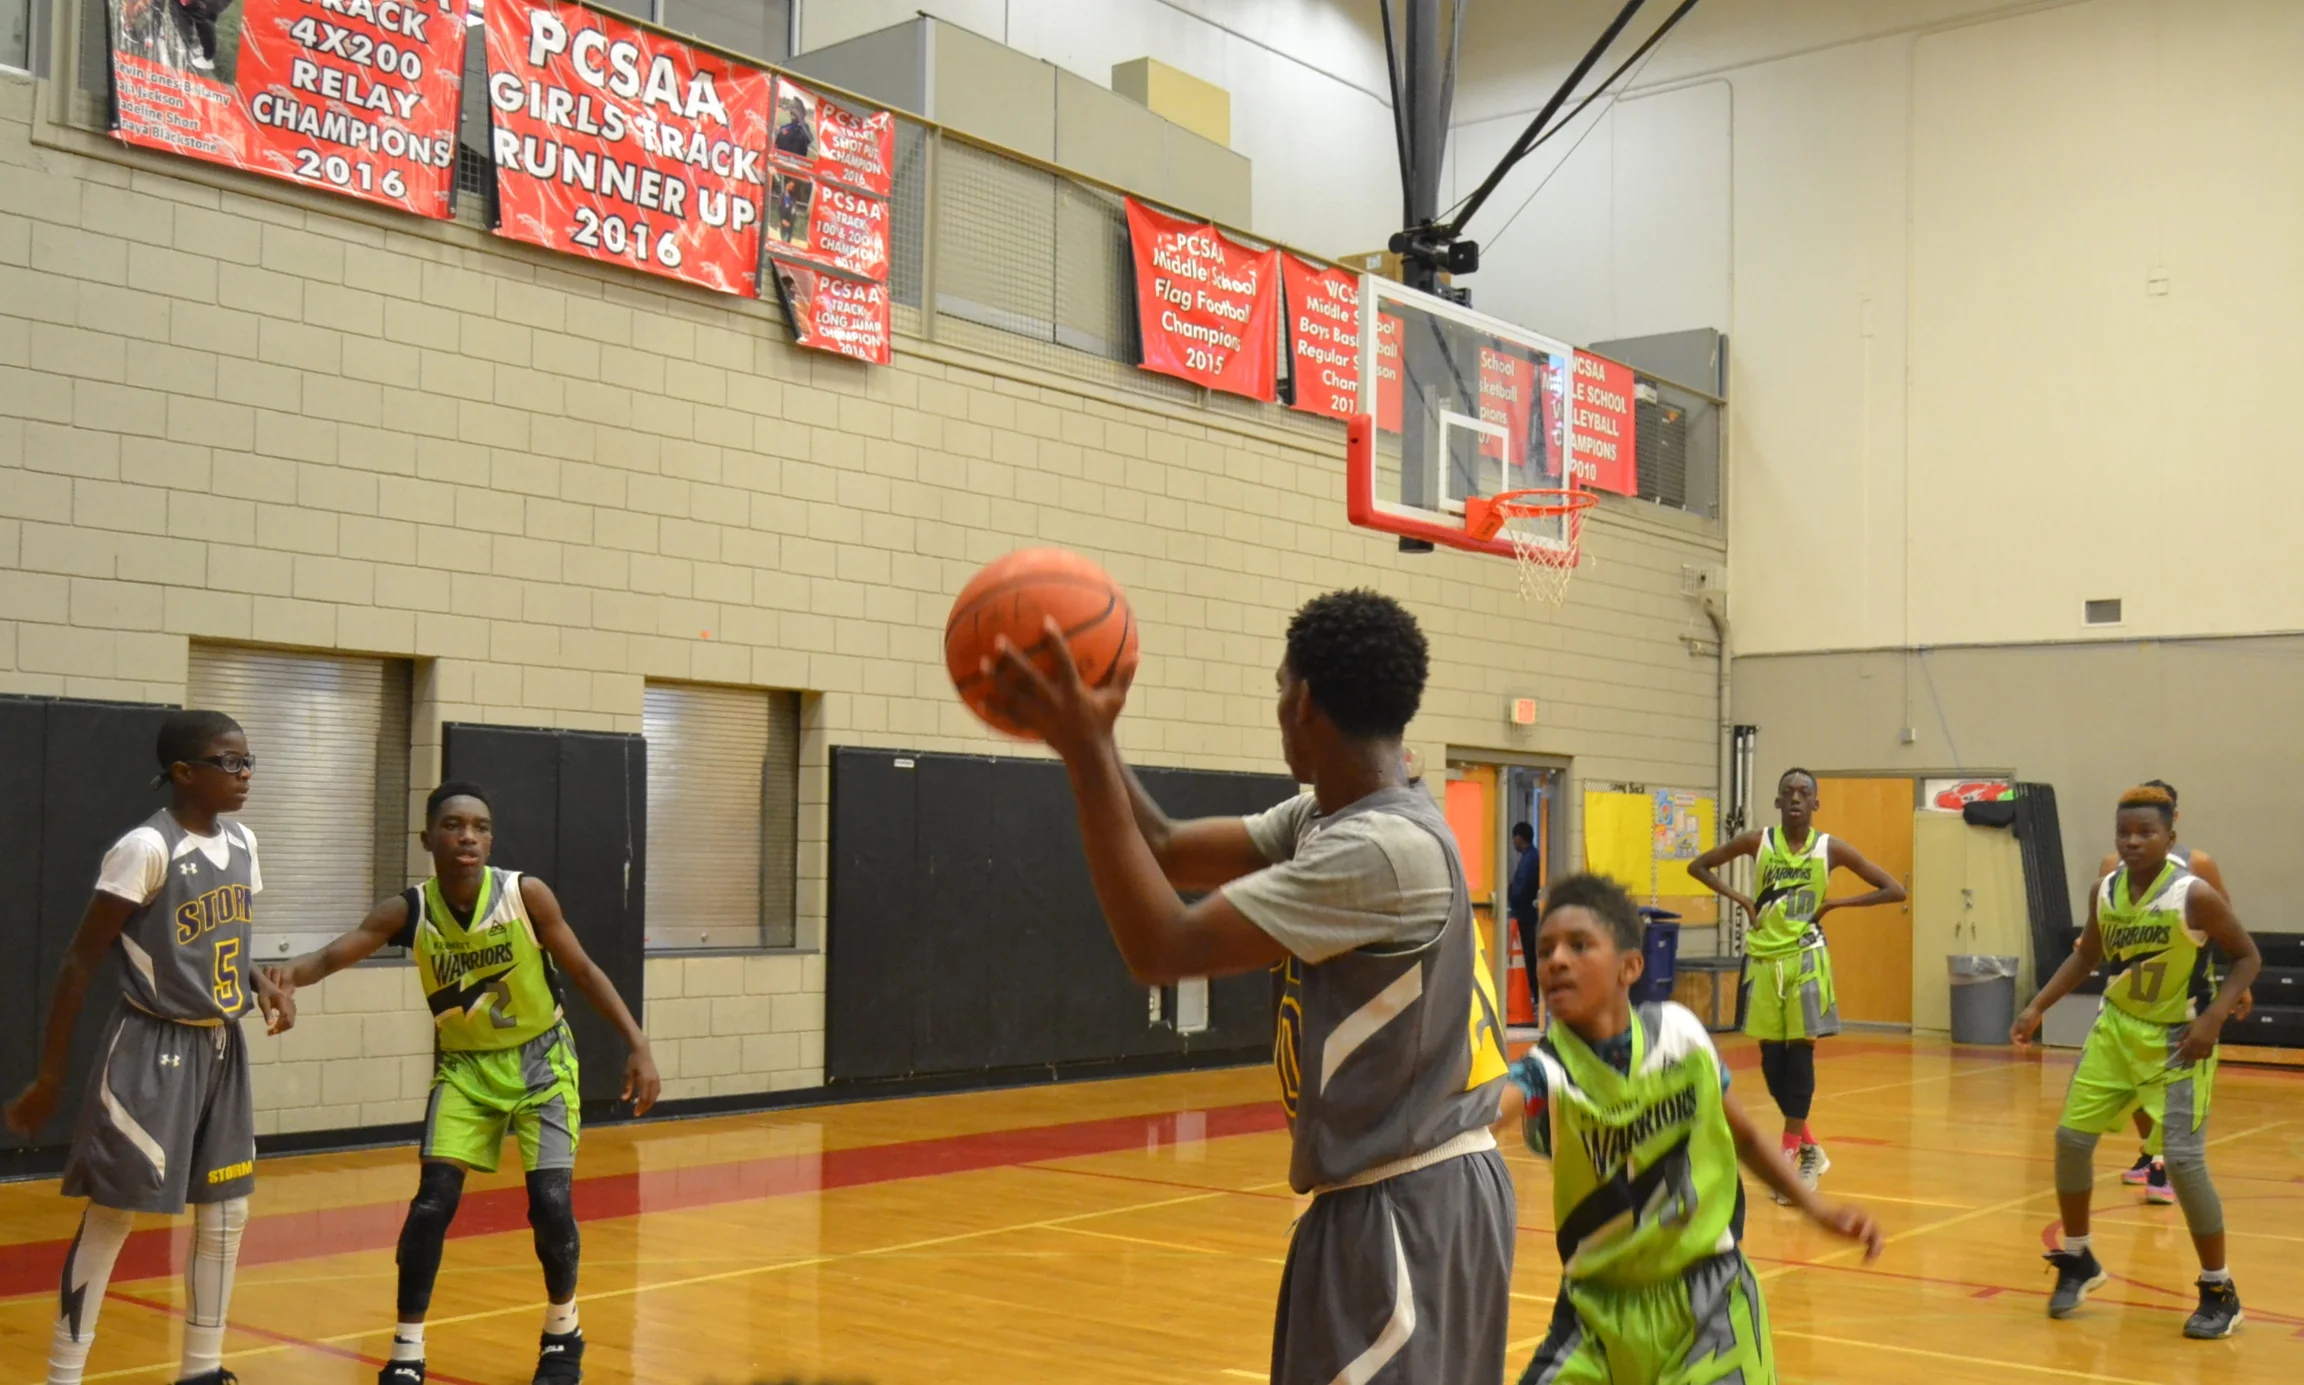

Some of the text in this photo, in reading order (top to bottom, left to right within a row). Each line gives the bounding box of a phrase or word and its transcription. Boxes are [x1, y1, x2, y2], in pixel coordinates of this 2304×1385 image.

[304, 0, 430, 43] ACK
[290, 15, 422, 82] 4X200
[527, 10, 730, 128] PCSAA
[291, 58, 422, 120] RELAY
[120, 100, 199, 131] adeline Short
[251, 92, 452, 169] CHAMPIONS
[489, 70, 765, 186] GIRLS TRACK
[822, 104, 888, 132] PCSAA
[121, 119, 218, 153] naya Blackstone
[294, 148, 406, 198] 2016
[493, 125, 756, 234] RUNNER UP
[831, 150, 881, 175] CHAMPION
[822, 186, 881, 221] PCSAA
[836, 210, 866, 230] TRACK
[572, 205, 682, 268] 2016
[816, 220, 836, 236] 100
[1176, 232, 1226, 267] PCSAA
[1153, 247, 1257, 297] Middle School
[819, 276, 881, 305] PCSAA
[831, 299, 866, 317] TRACK
[1155, 277, 1192, 312] Flag
[815, 311, 882, 333] LONG JUMP
[1306, 295, 1349, 323] Middle
[1162, 310, 1241, 353] Champions
[1299, 316, 1331, 341] Boys
[1185, 347, 1225, 376] 2015
[1298, 338, 1349, 367] Regular
[1480, 350, 1516, 378] School
[1331, 394, 1358, 415] 201
[1479, 376, 1518, 402] sketball
[1587, 385, 1628, 416] SCHOOL
[1552, 401, 1620, 438] VLEYBALL
[1553, 426, 1617, 463] CAMPIONS
[2101, 923, 2171, 964] WARRIORS
[213, 937, 243, 1012] 5
[431, 942, 514, 988] WARRIORS
[2128, 961, 2168, 1003] 17
[485, 980, 517, 1030] 2
[207, 1159, 254, 1185] STORM
